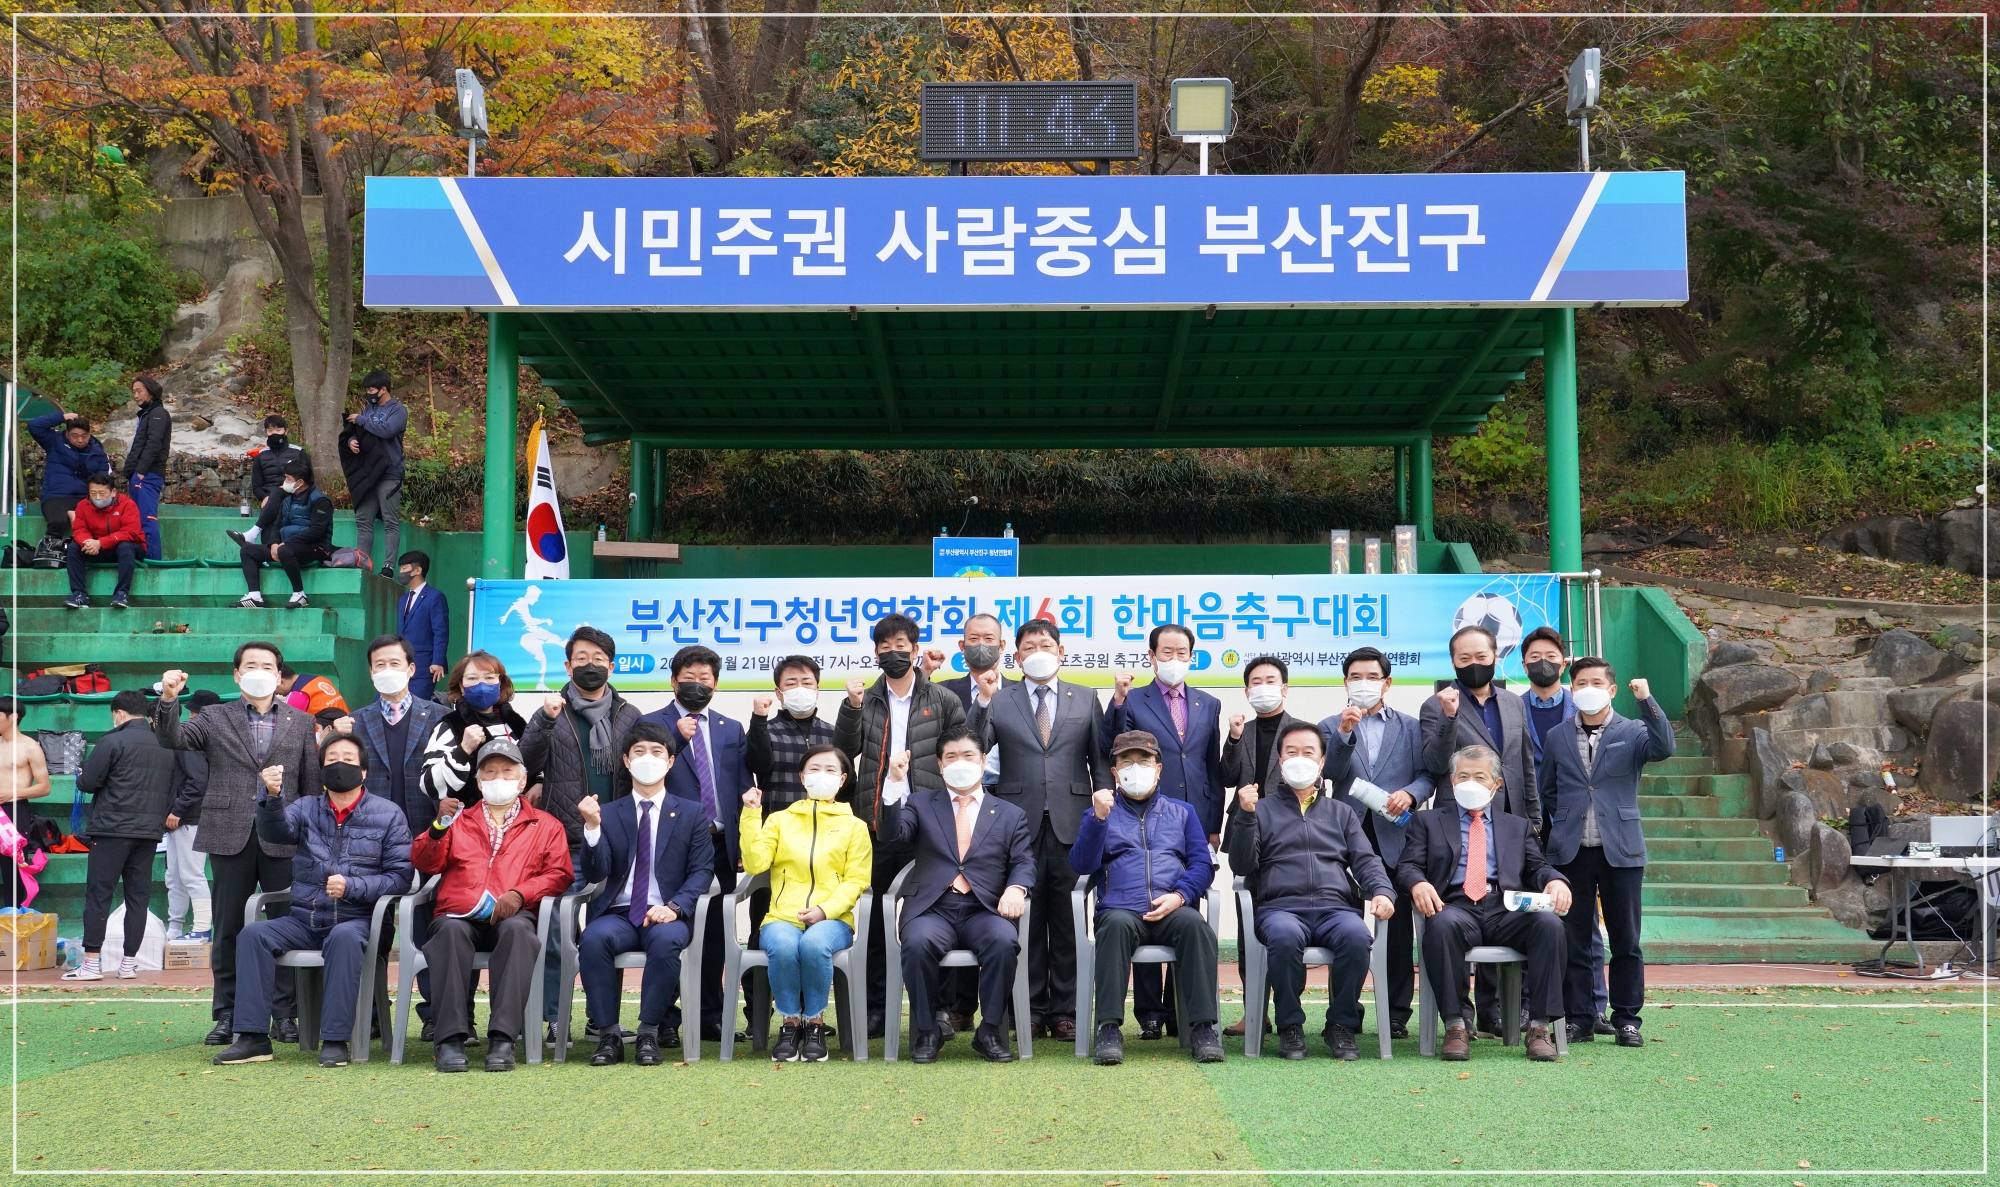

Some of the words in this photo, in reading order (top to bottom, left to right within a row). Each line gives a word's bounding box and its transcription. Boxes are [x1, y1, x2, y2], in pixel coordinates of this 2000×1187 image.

[563, 206, 847, 276] 시민주권
[876, 205, 1167, 277] 사람중심
[1199, 203, 1486, 274] 부산진구
[1111, 591, 1388, 640] 한마음축구대회
[618, 655, 645, 671] 일시
